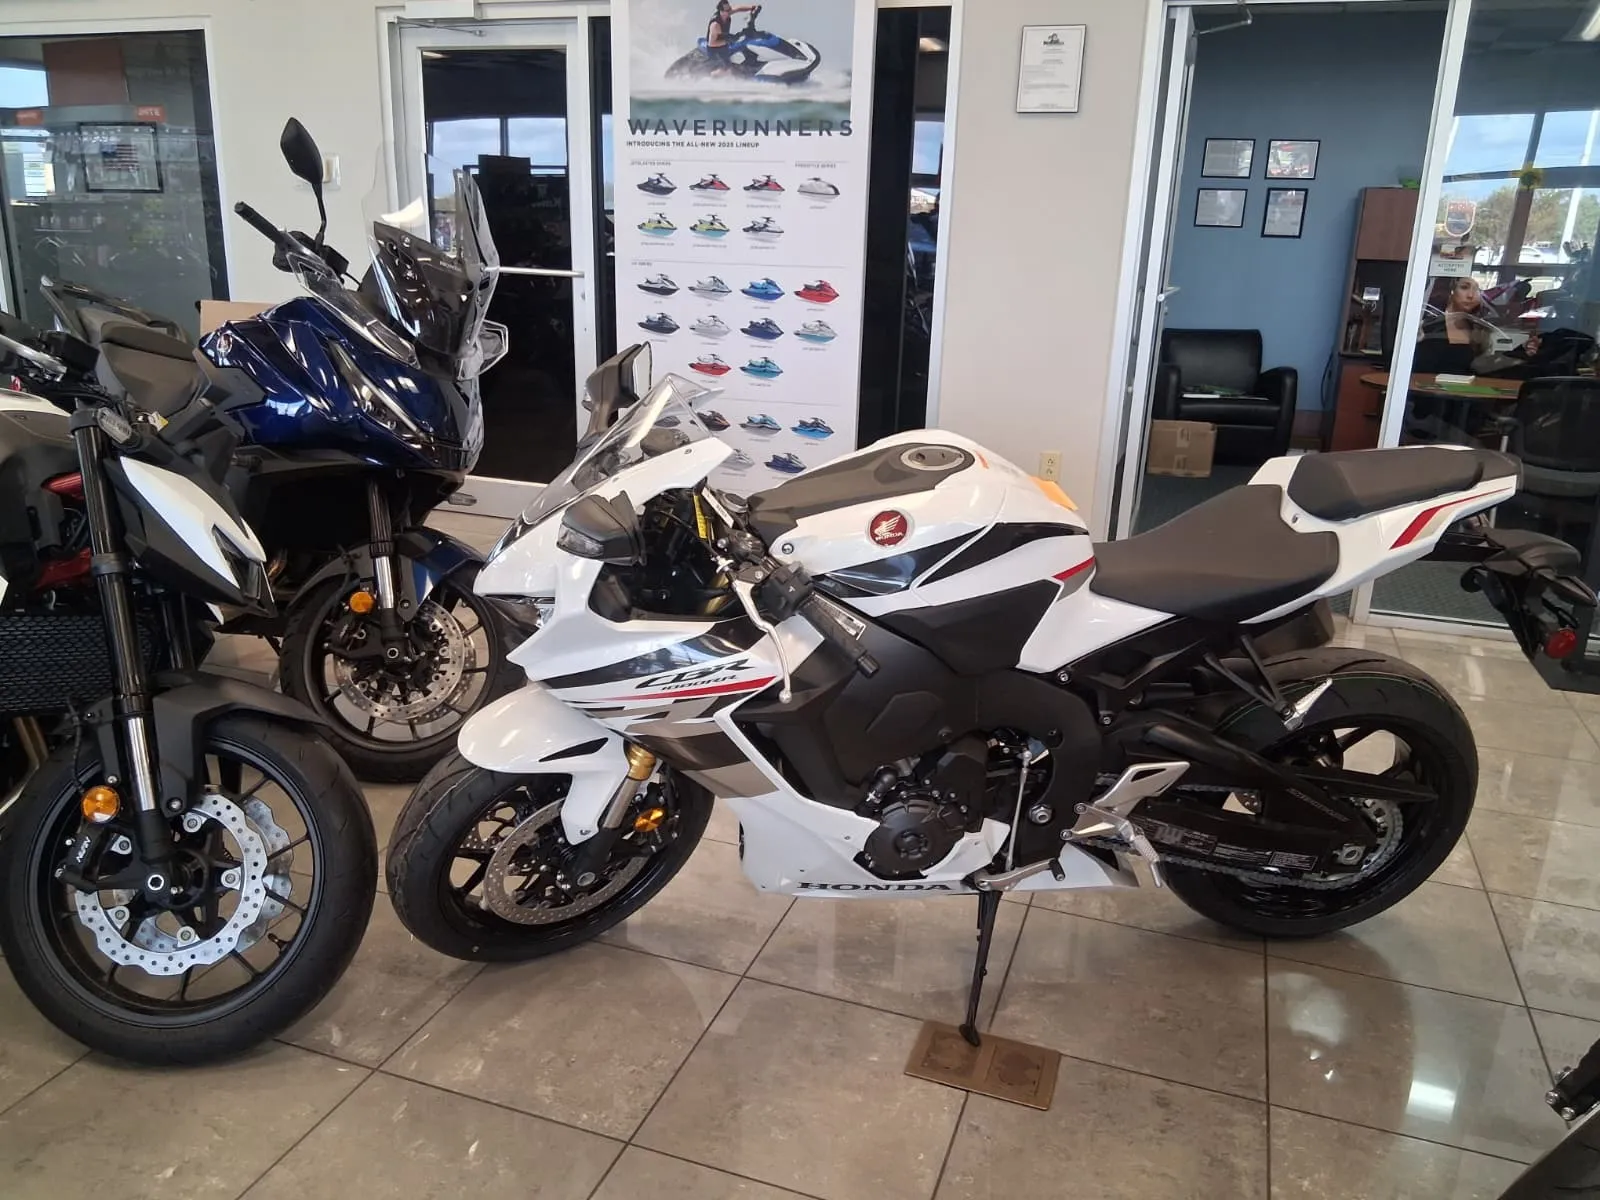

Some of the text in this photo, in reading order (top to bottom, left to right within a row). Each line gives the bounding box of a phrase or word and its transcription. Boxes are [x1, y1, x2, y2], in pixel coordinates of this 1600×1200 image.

[627, 119, 853, 137] WAVERUNNERS
[635, 658, 756, 689] CBR
[796, 882, 952, 891] HONDA
